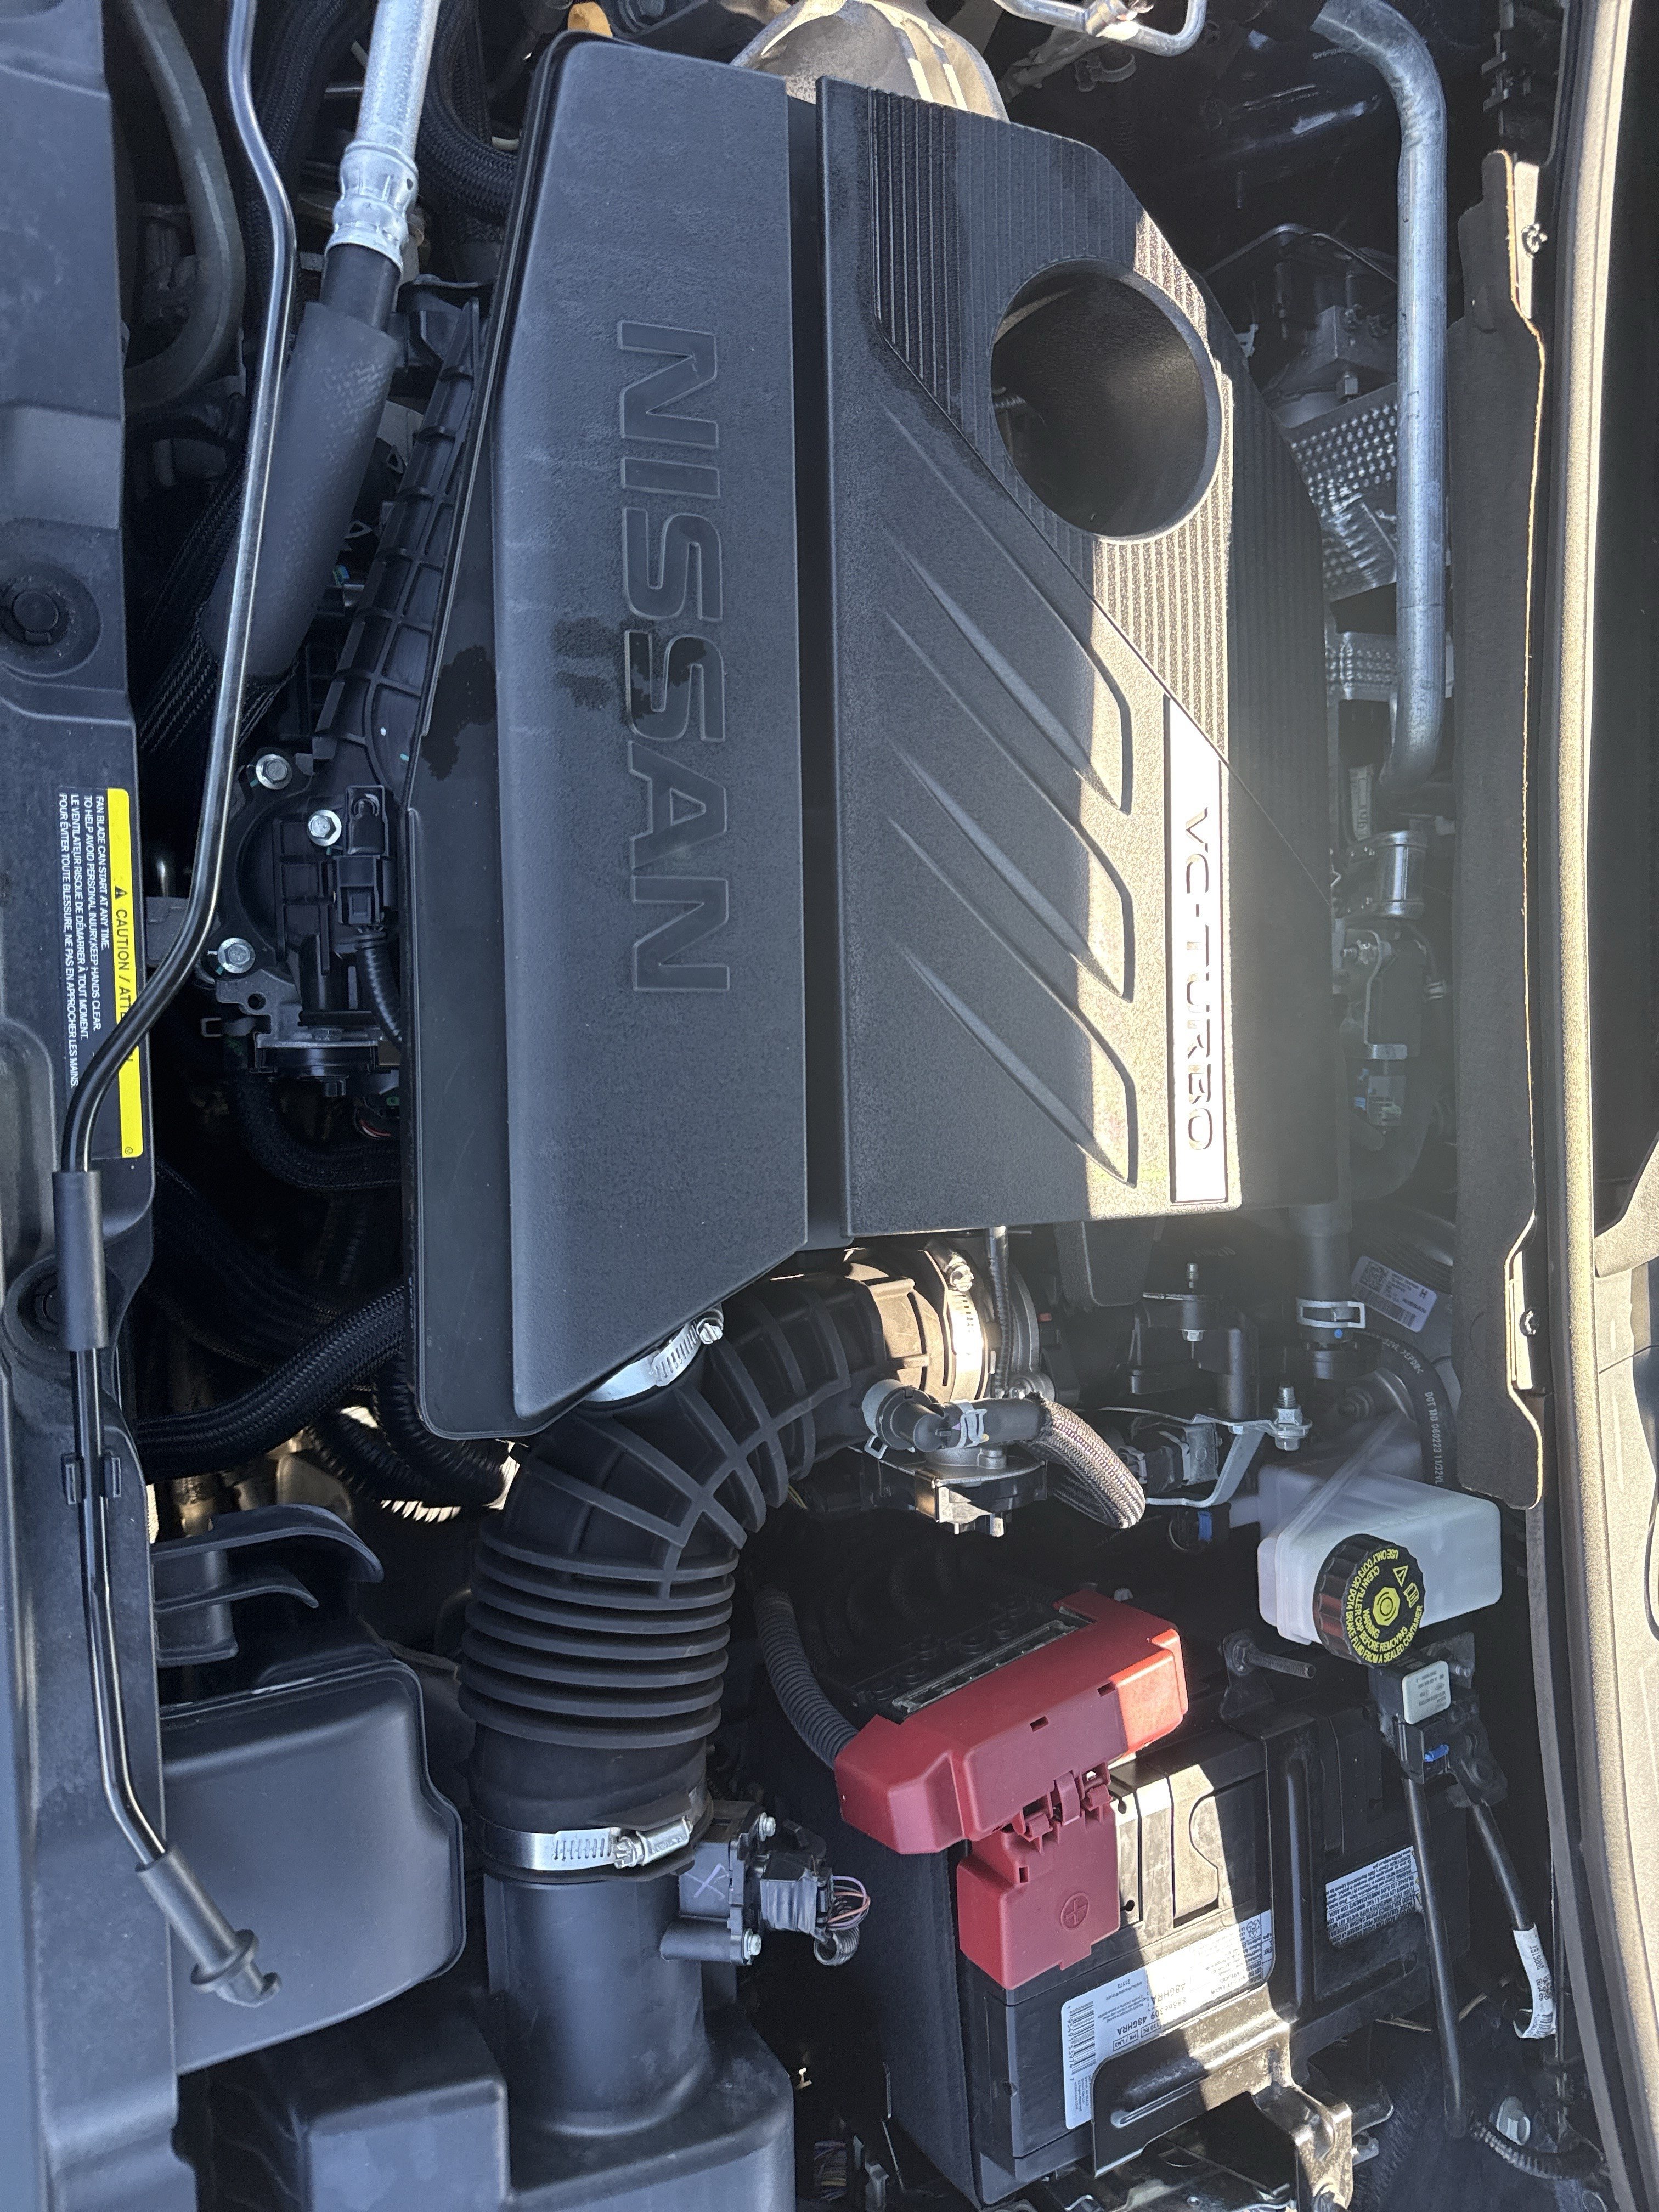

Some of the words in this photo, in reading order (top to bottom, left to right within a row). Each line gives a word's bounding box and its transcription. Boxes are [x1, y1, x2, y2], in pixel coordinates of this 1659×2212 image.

[618, 321, 730, 991] NISSAN
[59, 794, 68, 820] POUR
[70, 794, 78, 806] LE
[83, 795, 92, 808] TO
[94, 795, 104, 814] FAN
[84, 810, 93, 832] HELP
[95, 815, 105, 844] BLADE
[59, 821, 71, 851] ÉVITER
[70, 807, 81, 864] VENTILATEUR
[84, 834, 94, 861] AVOID
[97, 845, 106, 865] CAN
[61, 853, 70, 882] TOUTE
[72, 866, 83, 900] RISQUE
[86, 863, 97, 910] PERSONAL
[98, 867, 107, 894] START
[60, 884, 72, 932] BLESSURE,
[75, 901, 83, 913] DE
[99, 895, 108, 907] AT
[99, 908, 109, 926] ANY
[64, 934, 72, 947] NE
[75, 915, 88, 964] DÉMARRER
[100, 928, 109, 950] TIME.
[115, 909, 129, 970] CAUTION
[65, 949, 74, 966] PAS
[66, 968, 74, 980] EN
[77, 974, 87, 997] TOUT
[90, 967, 99, 998] HANDS
[1186, 809, 1212, 1150] VC-TURBO
[66, 981, 76, 1037] APPROCHER
[78, 999, 88, 1040] MOMENT.
[91, 1000, 101, 1031] CLEAR.
[69, 1039, 77, 1056] LES
[69, 1058, 78, 1087] MAINS.
[1430, 1423, 1441, 1453] 060223
[1372, 1550, 1387, 1564] ONLY
[1387, 1549, 1398, 1559] USE
[1357, 1558, 1373, 1576] DOT3
[1361, 1565, 1380, 1589] CLEAN
[1351, 1576, 1361, 1588] OR
[1346, 1588, 1355, 1609] DOT4
[1354, 1587, 1365, 1616] FILLER
[1346, 1611, 1356, 1639] BRAKE
[1355, 1616, 1364, 1632] CAP
[1362, 1607, 1380, 1639] WARNING
[1403, 1605, 1423, 1646] CONTAINER
[1350, 1635, 1365, 1656] FLUID
[1359, 1630, 1380, 1651] BEFORE
[1379, 1626, 1408, 1651] REMOVING
[1362, 1649, 1378, 1663] FROM
[1383, 1643, 1404, 1663] SEALED
[1150, 1980, 1186, 2006] 48GHRA
[1116, 2015, 1147, 2036] 48GHRA
